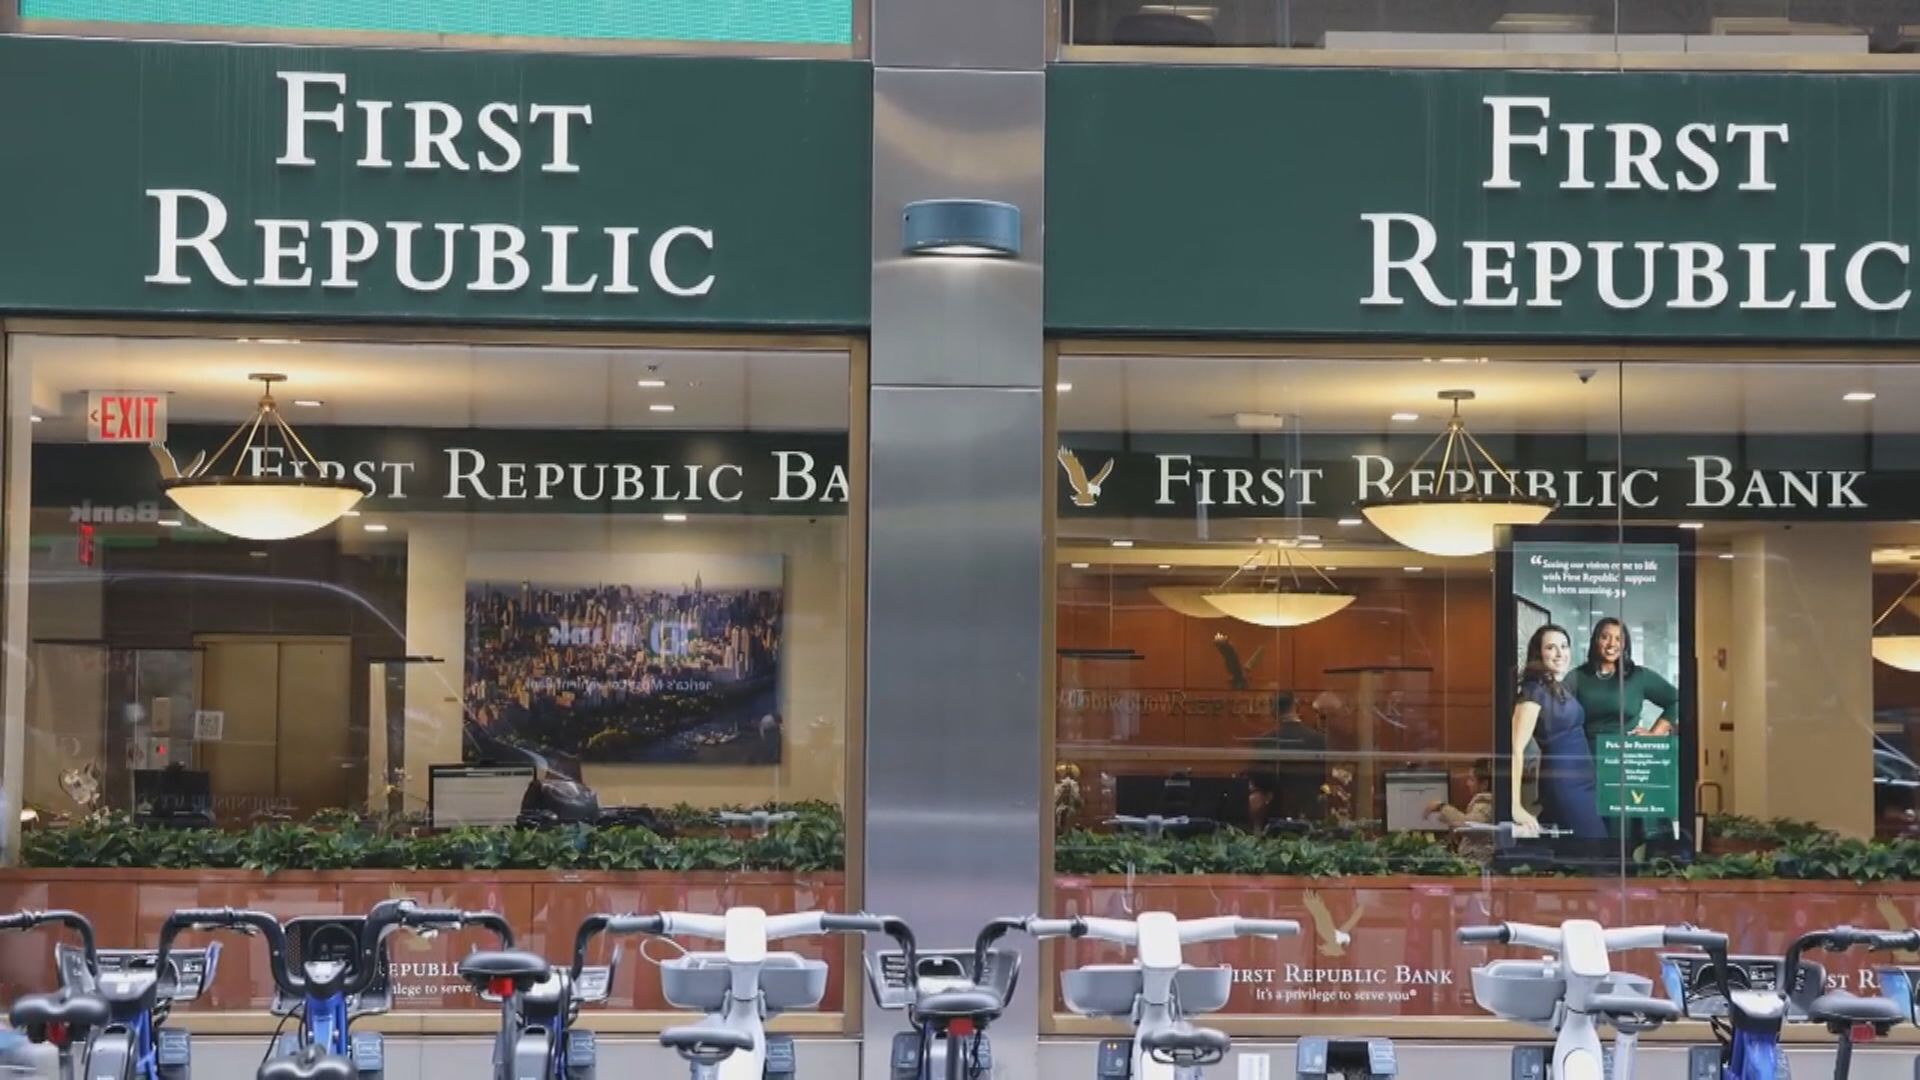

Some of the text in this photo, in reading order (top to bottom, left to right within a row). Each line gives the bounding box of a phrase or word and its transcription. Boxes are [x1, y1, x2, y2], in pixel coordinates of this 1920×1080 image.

[276, 70, 593, 173] FIRST
[1482, 95, 1789, 192] FIRST
[144, 188, 716, 297] REPUBLIC
[1360, 212, 1911, 311] REPUBLIC
[101, 397, 158, 438] EXIT
[442, 448, 743, 501] REPUBLIC
[1154, 454, 1868, 508] FIRST REPUBLIC BANK
[379, 960, 459, 977] EPUBLI
[424, 985, 438, 995] to
[1219, 963, 1453, 985] IRST REPUBLIC BANK
[1256, 987, 1273, 1001] It's
[1275, 991, 1283, 1001] a
[1285, 987, 1336, 1003] privilege
[1339, 990, 1351, 1001] to
[1354, 991, 1385, 1001] serve
